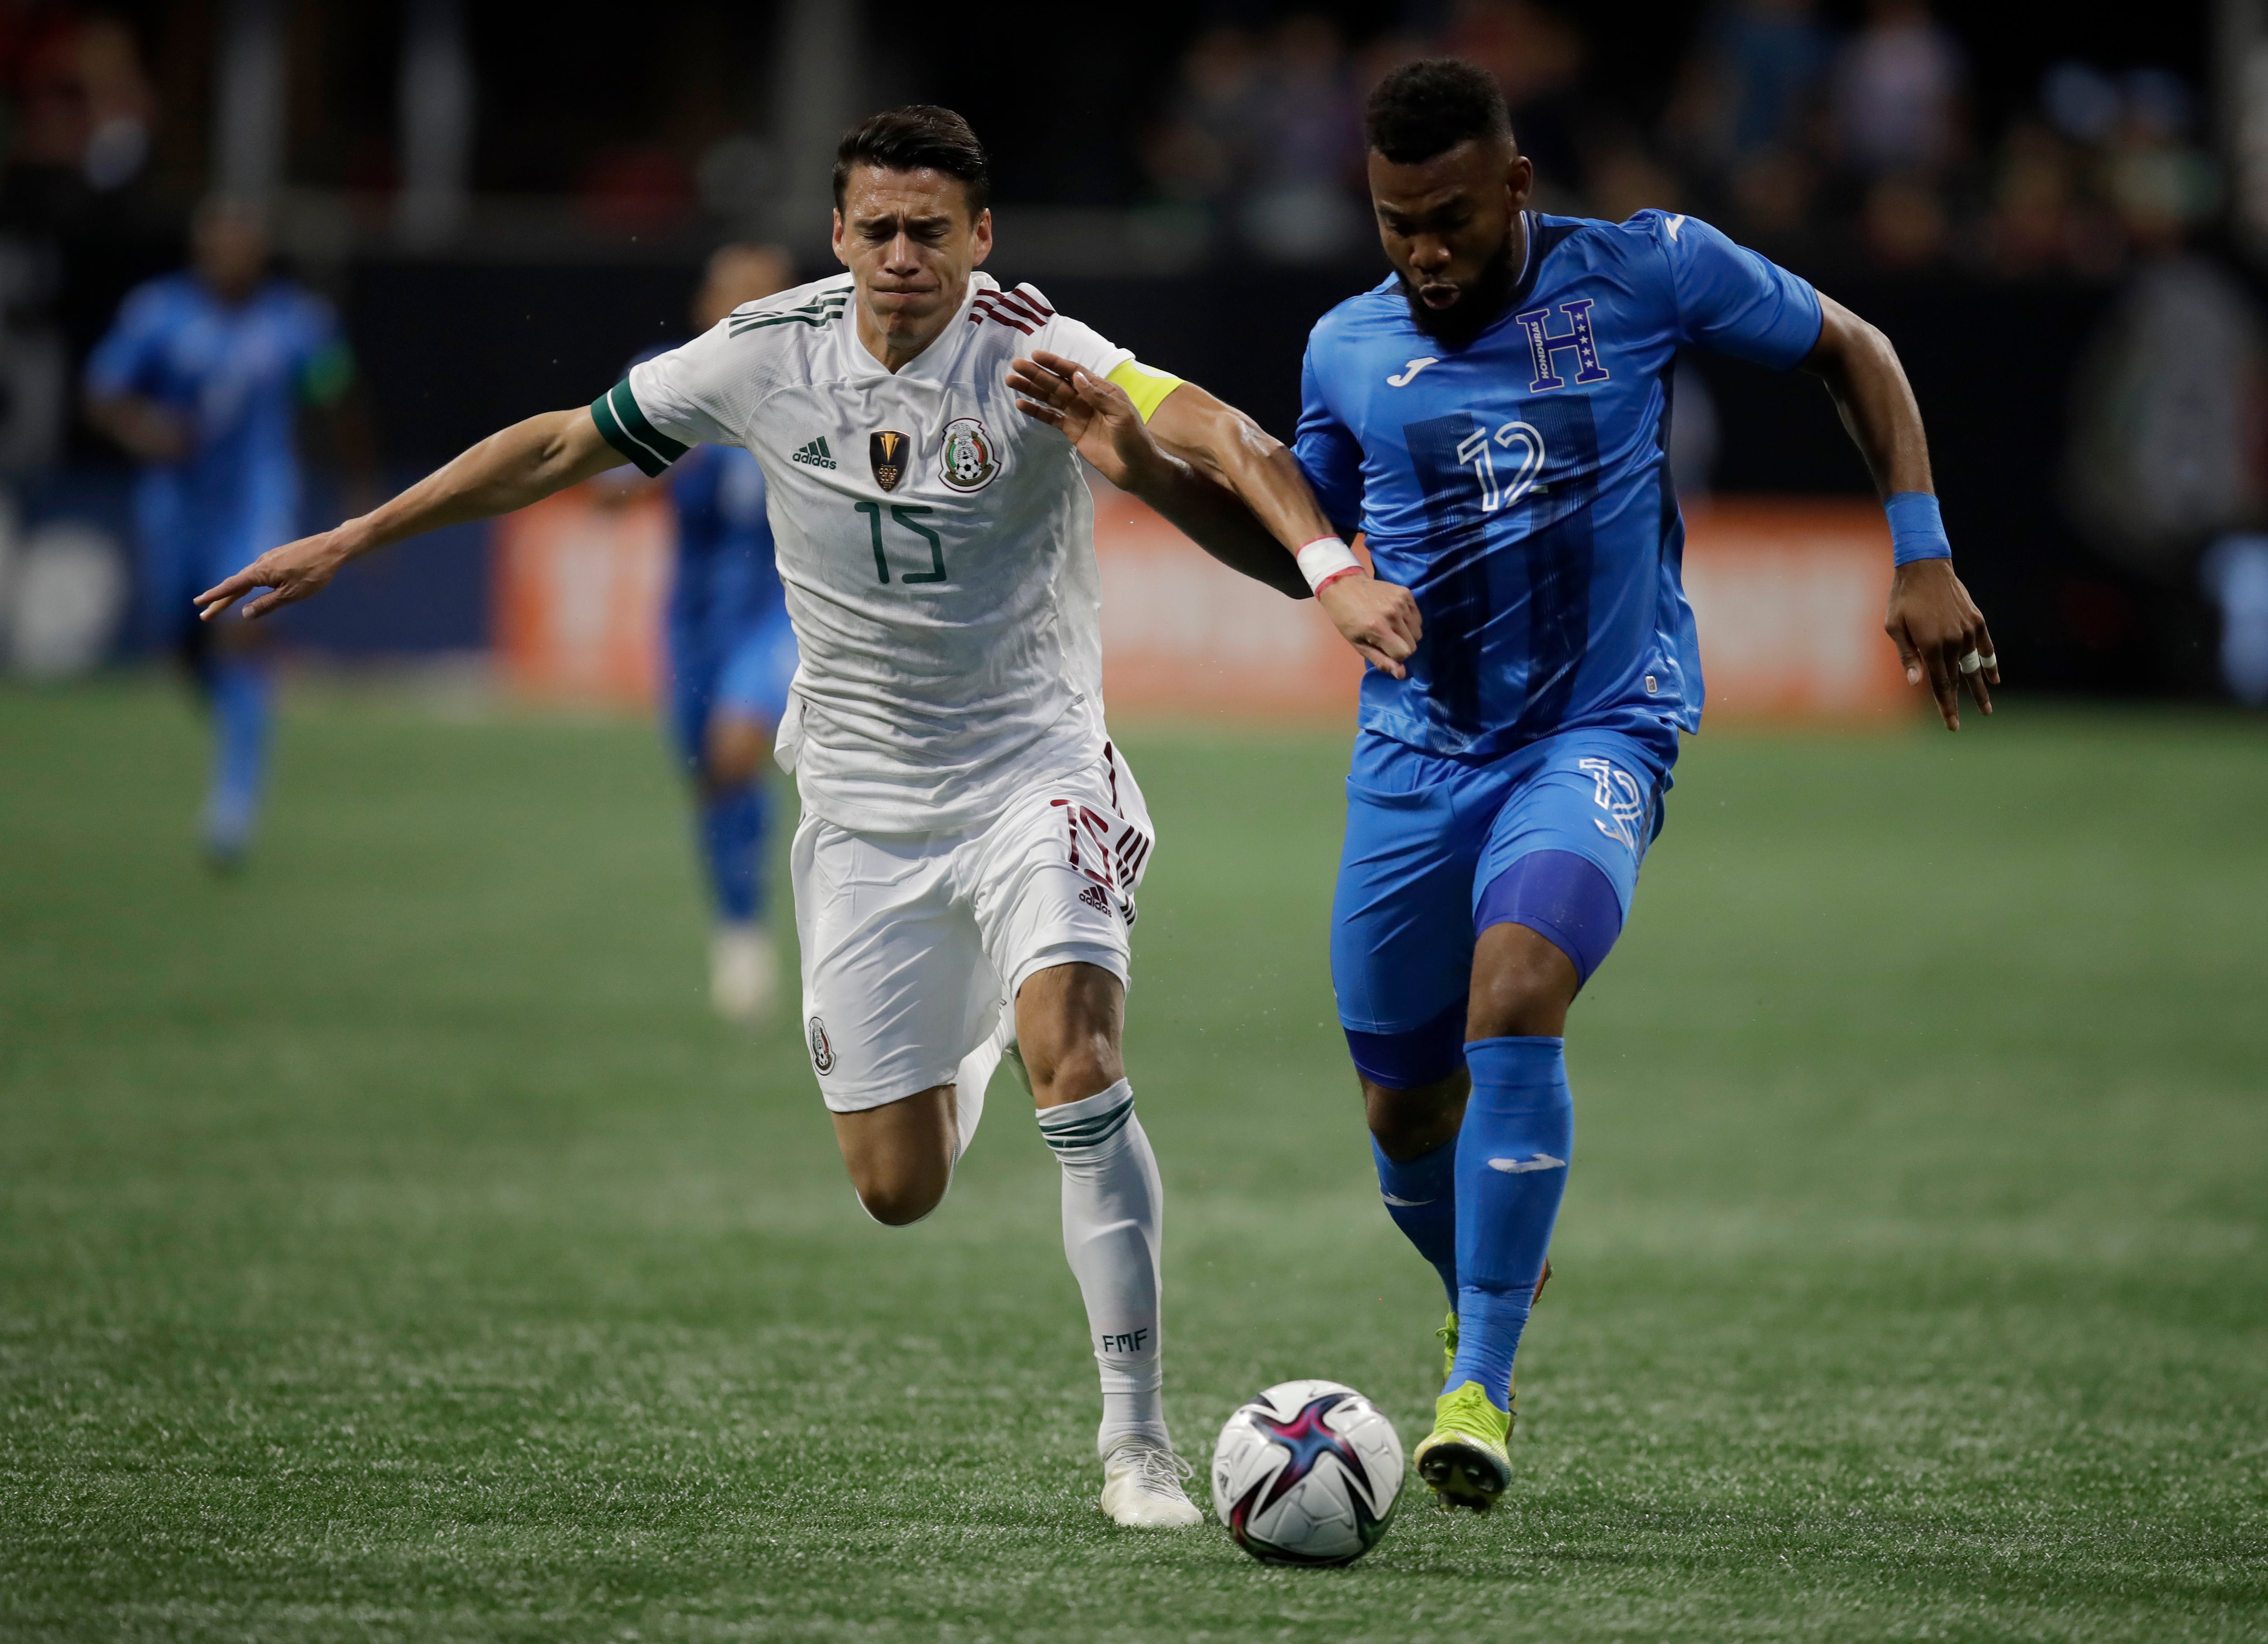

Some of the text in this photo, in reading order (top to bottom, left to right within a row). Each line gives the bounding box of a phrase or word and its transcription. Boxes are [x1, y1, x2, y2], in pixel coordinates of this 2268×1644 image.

[1531, 321, 1549, 379] HONDURAS
[792, 453, 837, 470] adidas
[1457, 421, 1548, 512] 12
[855, 502, 947, 584] 15
[1579, 758, 1642, 850] 12
[1050, 799, 1115, 893] 15
[1079, 893, 1112, 918] adidas
[1102, 1328, 1147, 1352] FMF
